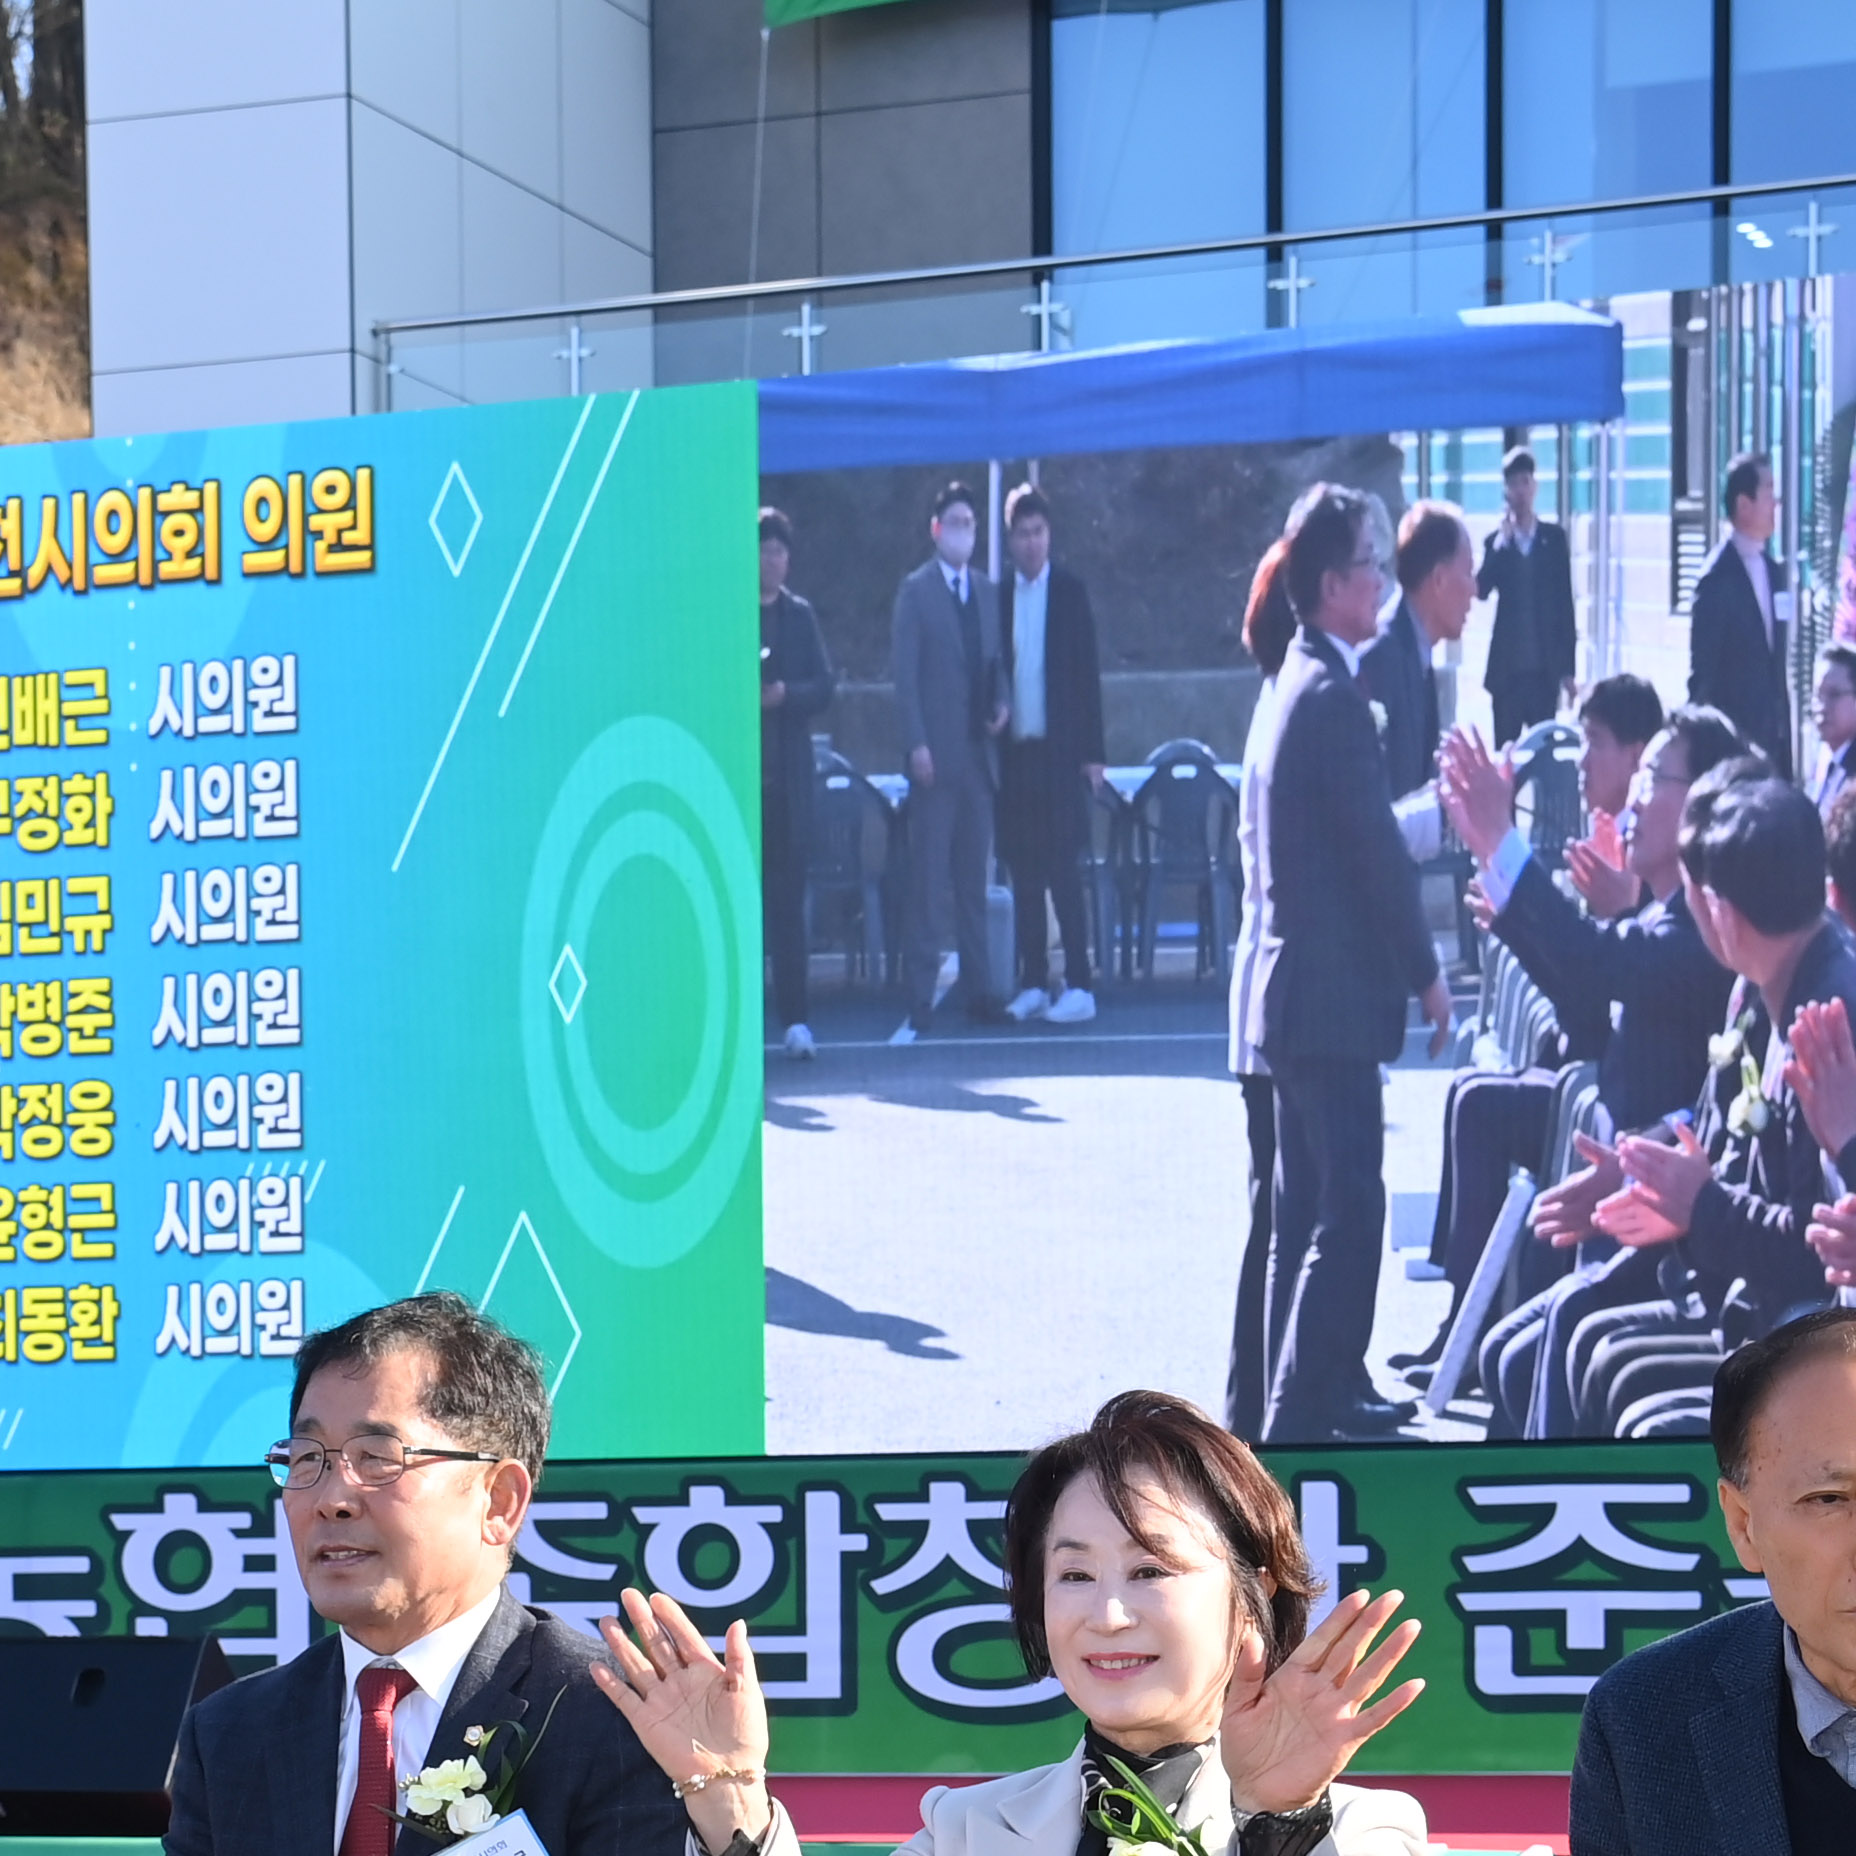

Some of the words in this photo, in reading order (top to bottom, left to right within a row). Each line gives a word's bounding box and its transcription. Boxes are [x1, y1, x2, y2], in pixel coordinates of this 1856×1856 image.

[241, 465, 377, 581] 의원
[148, 653, 299, 740] 시의원
[149, 759, 301, 843] 시의원
[150, 863, 302, 947] 시의원
[151, 968, 303, 1050] 시의원
[152, 1071, 304, 1152] 시의원
[153, 1176, 305, 1256] 시의원
[155, 1279, 306, 1359] 시의원
